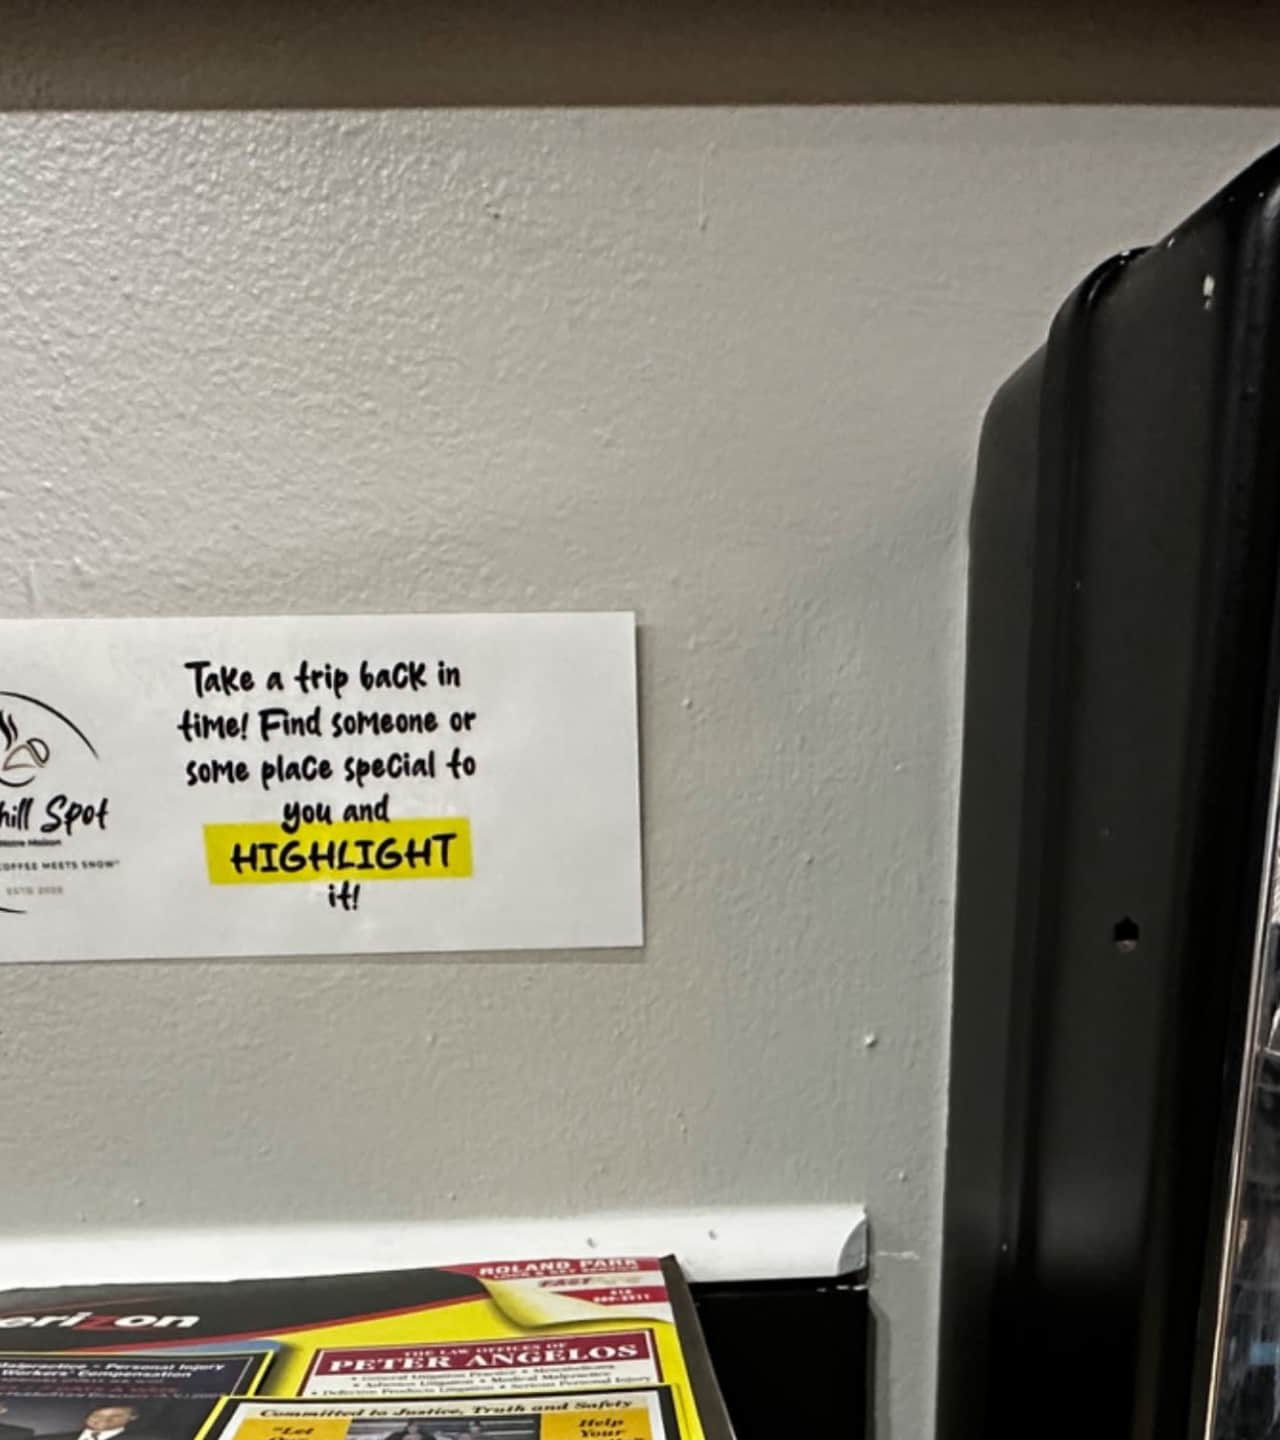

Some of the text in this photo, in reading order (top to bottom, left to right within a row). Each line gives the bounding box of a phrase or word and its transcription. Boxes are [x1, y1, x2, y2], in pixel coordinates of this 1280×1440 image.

[184, 660, 254, 698] Take
[267, 671, 284, 691] a
[294, 660, 348, 699] trip
[438, 660, 461, 688] in
[177, 706, 476, 742] time! Find someone or
[186, 760, 249, 786] some
[447, 747, 476, 779] to
[40, 794, 108, 836] Spot
[281, 793, 390, 834] you and
[42, 860, 77, 870] MEETS
[230, 833, 457, 874] HIGHLIGHT
[328, 880, 360, 911] it!
[329, 1343, 639, 1373] PETER ANGELOS
[260, 1400, 632, 1418] Committed to Justice, Truth and Safety
[579, 1419, 624, 1428] Help
[579, 1430, 624, 1438] Your
